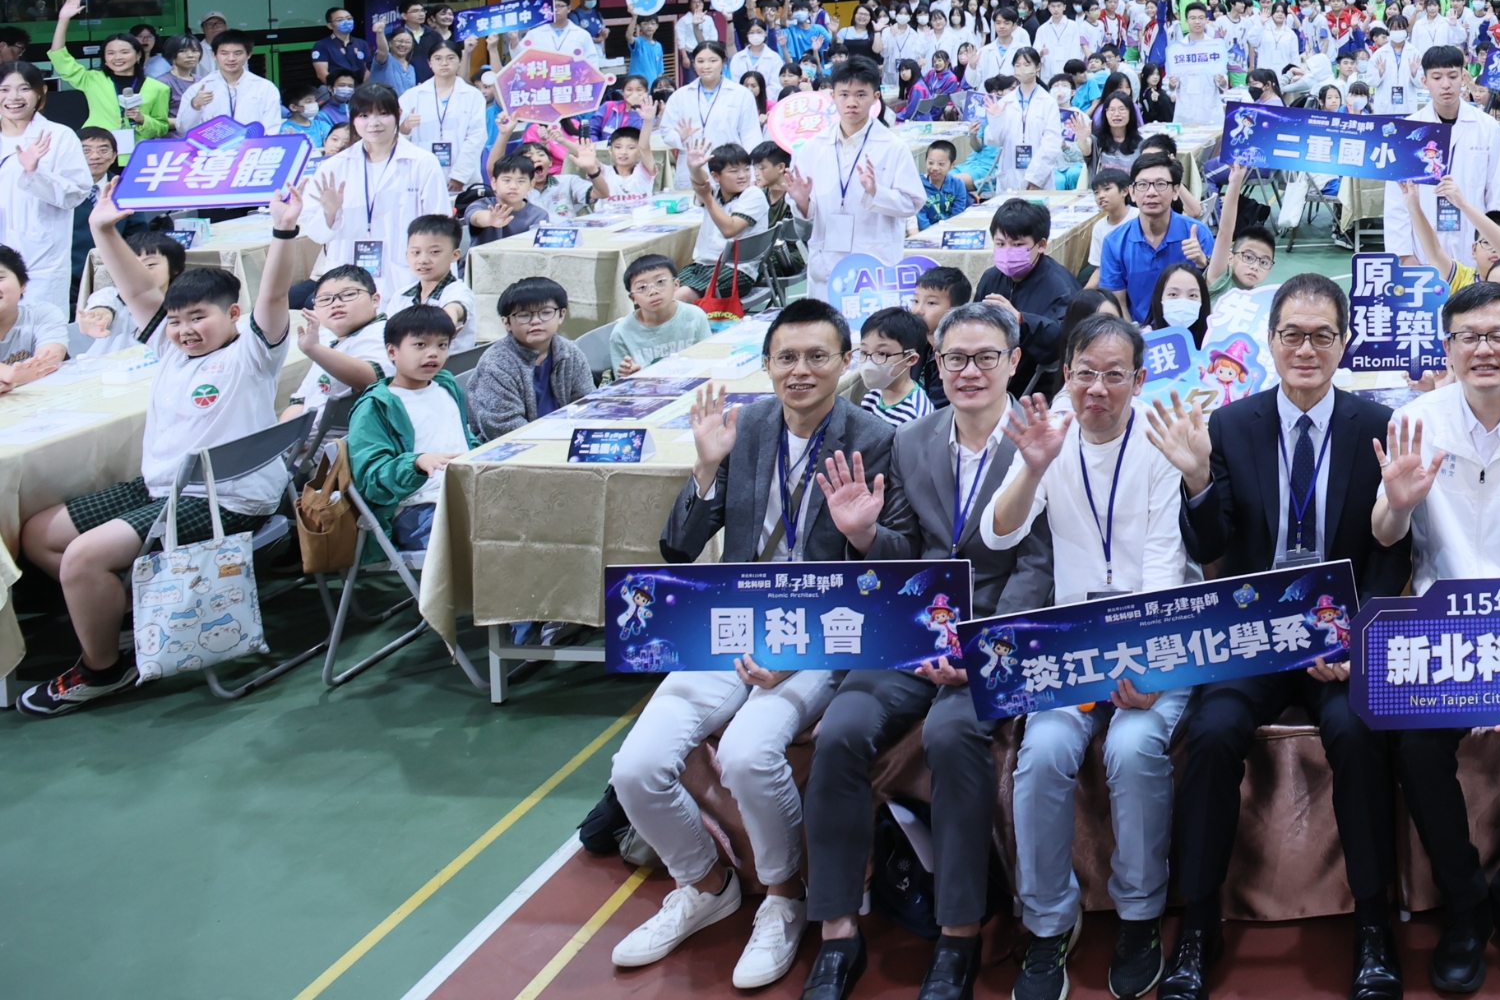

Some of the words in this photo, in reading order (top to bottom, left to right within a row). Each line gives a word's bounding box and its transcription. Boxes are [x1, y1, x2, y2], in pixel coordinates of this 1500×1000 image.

[526, 60, 572, 84] 科學
[509, 84, 594, 108] 啟迪智慧
[1272, 133, 1397, 170] 二重國小
[134, 146, 287, 191] 半導體
[854, 264, 922, 293] ALD
[1353, 258, 1435, 307] 原子
[1347, 304, 1443, 358] 建築
[1148, 342, 1180, 375] 我
[1352, 355, 1409, 368] Atomic
[579, 443, 620, 455] 二重國小
[737, 580, 771, 589] 新北科學日
[775, 573, 844, 594] 原子建築師
[1145, 592, 1219, 616] 原子建築師
[1105, 610, 1141, 623] 新北科學日
[1139, 618, 1162, 627] Atomic
[1163, 613, 1195, 623] Architect
[711, 606, 865, 655] 國科會
[1020, 614, 1312, 693] 淡江大學化學系
[1410, 695, 1437, 706] New
[1441, 693, 1479, 707] Taipei
